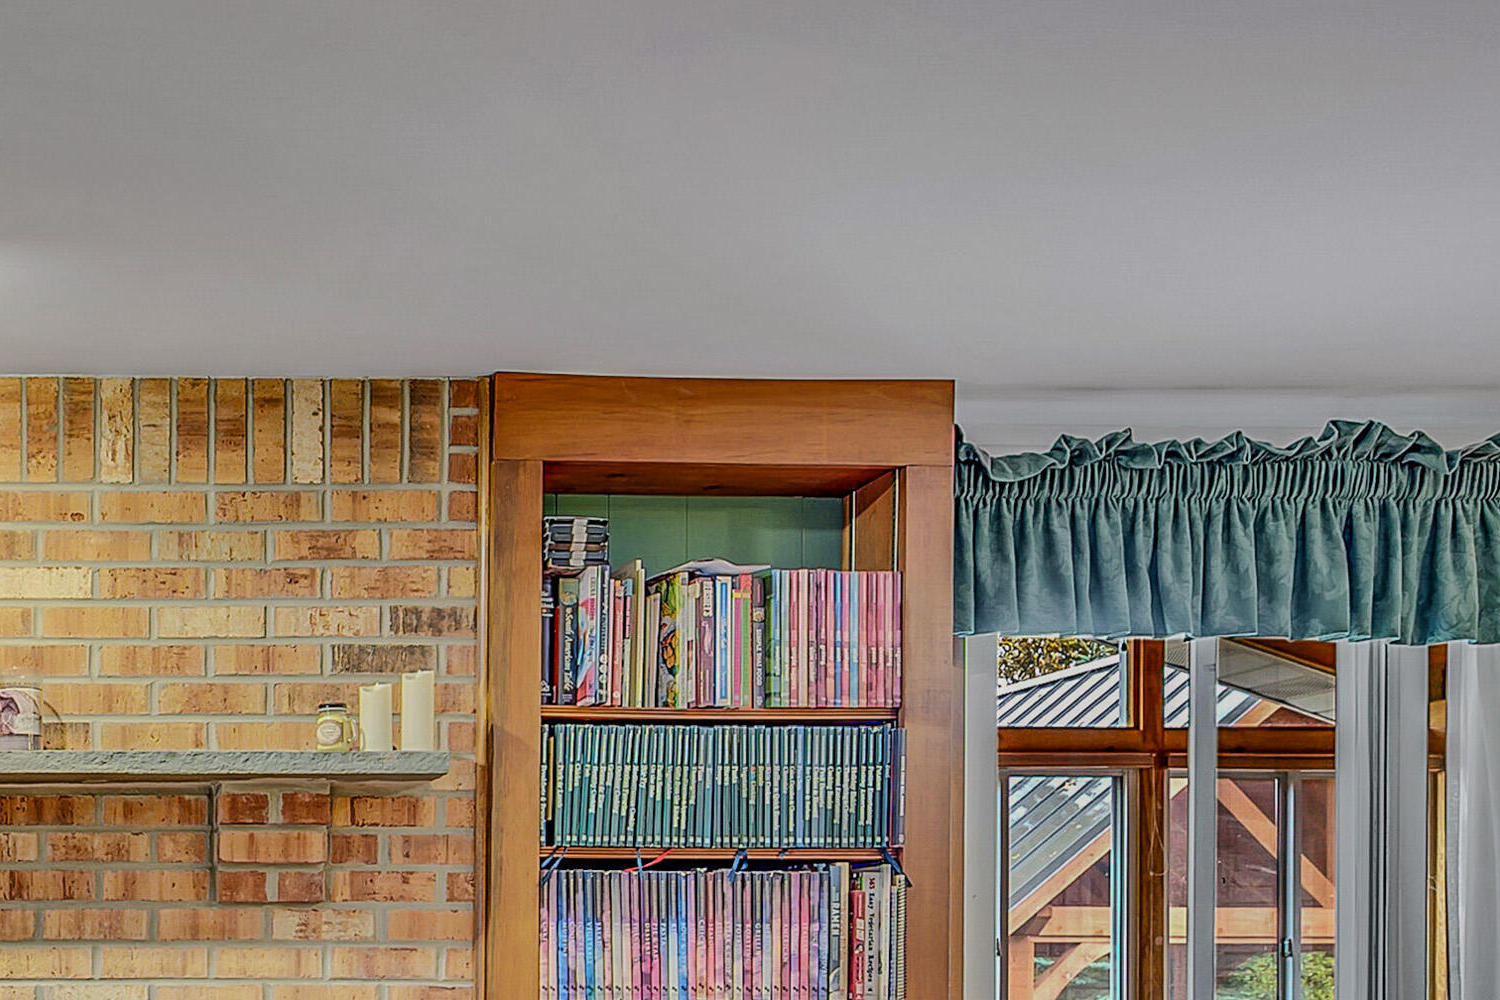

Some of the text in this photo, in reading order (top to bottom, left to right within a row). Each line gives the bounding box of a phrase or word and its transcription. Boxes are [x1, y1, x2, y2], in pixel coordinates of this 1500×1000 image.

[564, 614, 574, 691] South American Table
[867, 892, 875, 909] Easy
[831, 901, 840, 937] RAMEN
[867, 913, 875, 951] Vegetarian
[867, 955, 875, 982] Recipes
